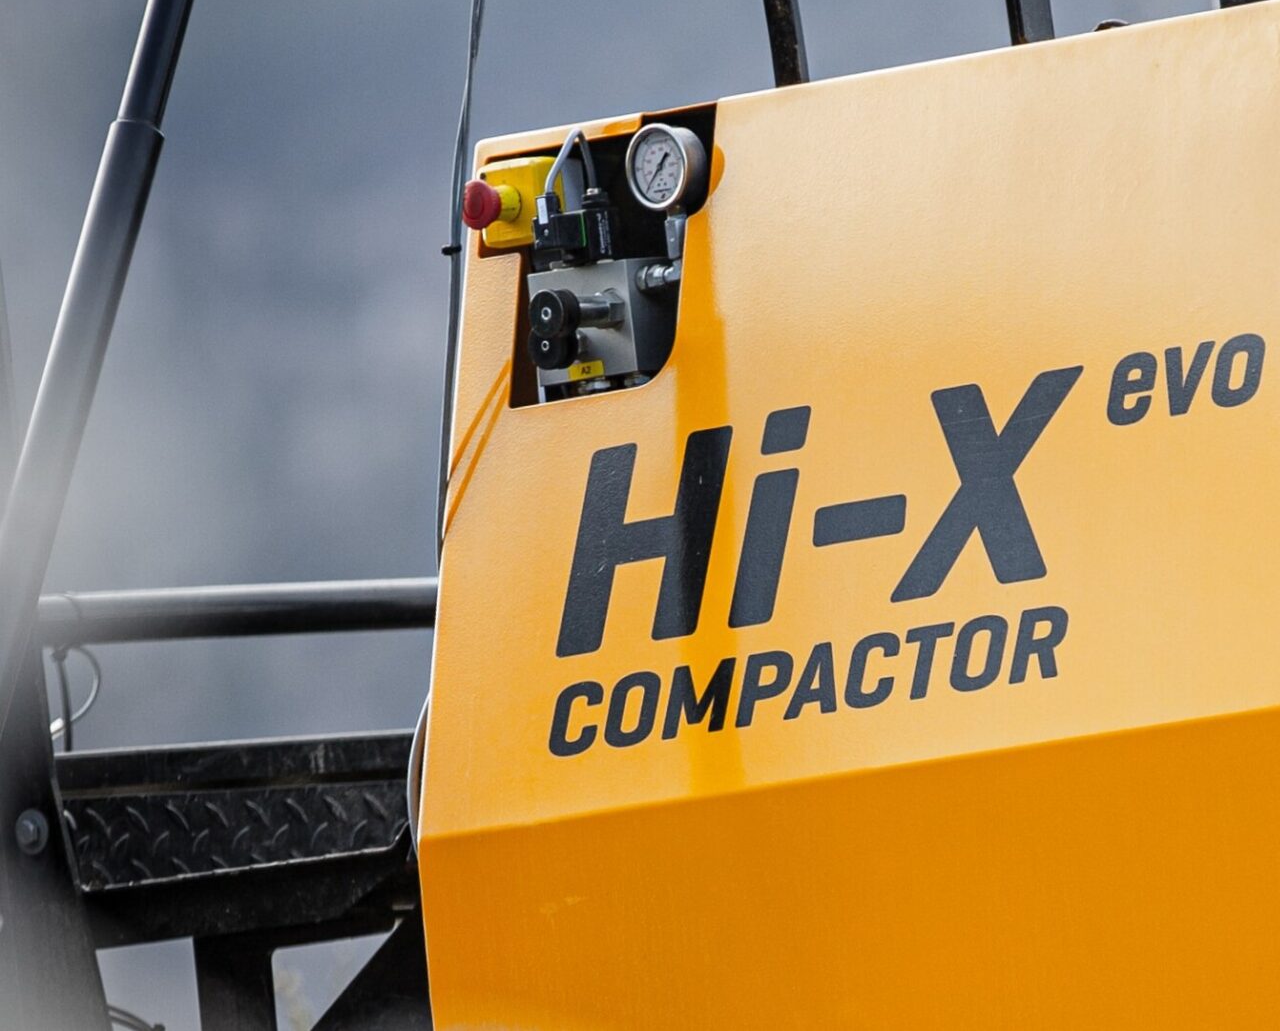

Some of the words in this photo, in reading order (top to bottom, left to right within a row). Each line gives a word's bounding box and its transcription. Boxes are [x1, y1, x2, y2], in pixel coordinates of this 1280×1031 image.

[556, 366, 1083, 657] Hi-X
[1107, 334, 1264, 425] evo
[549, 607, 1068, 756] COMPACTOR
